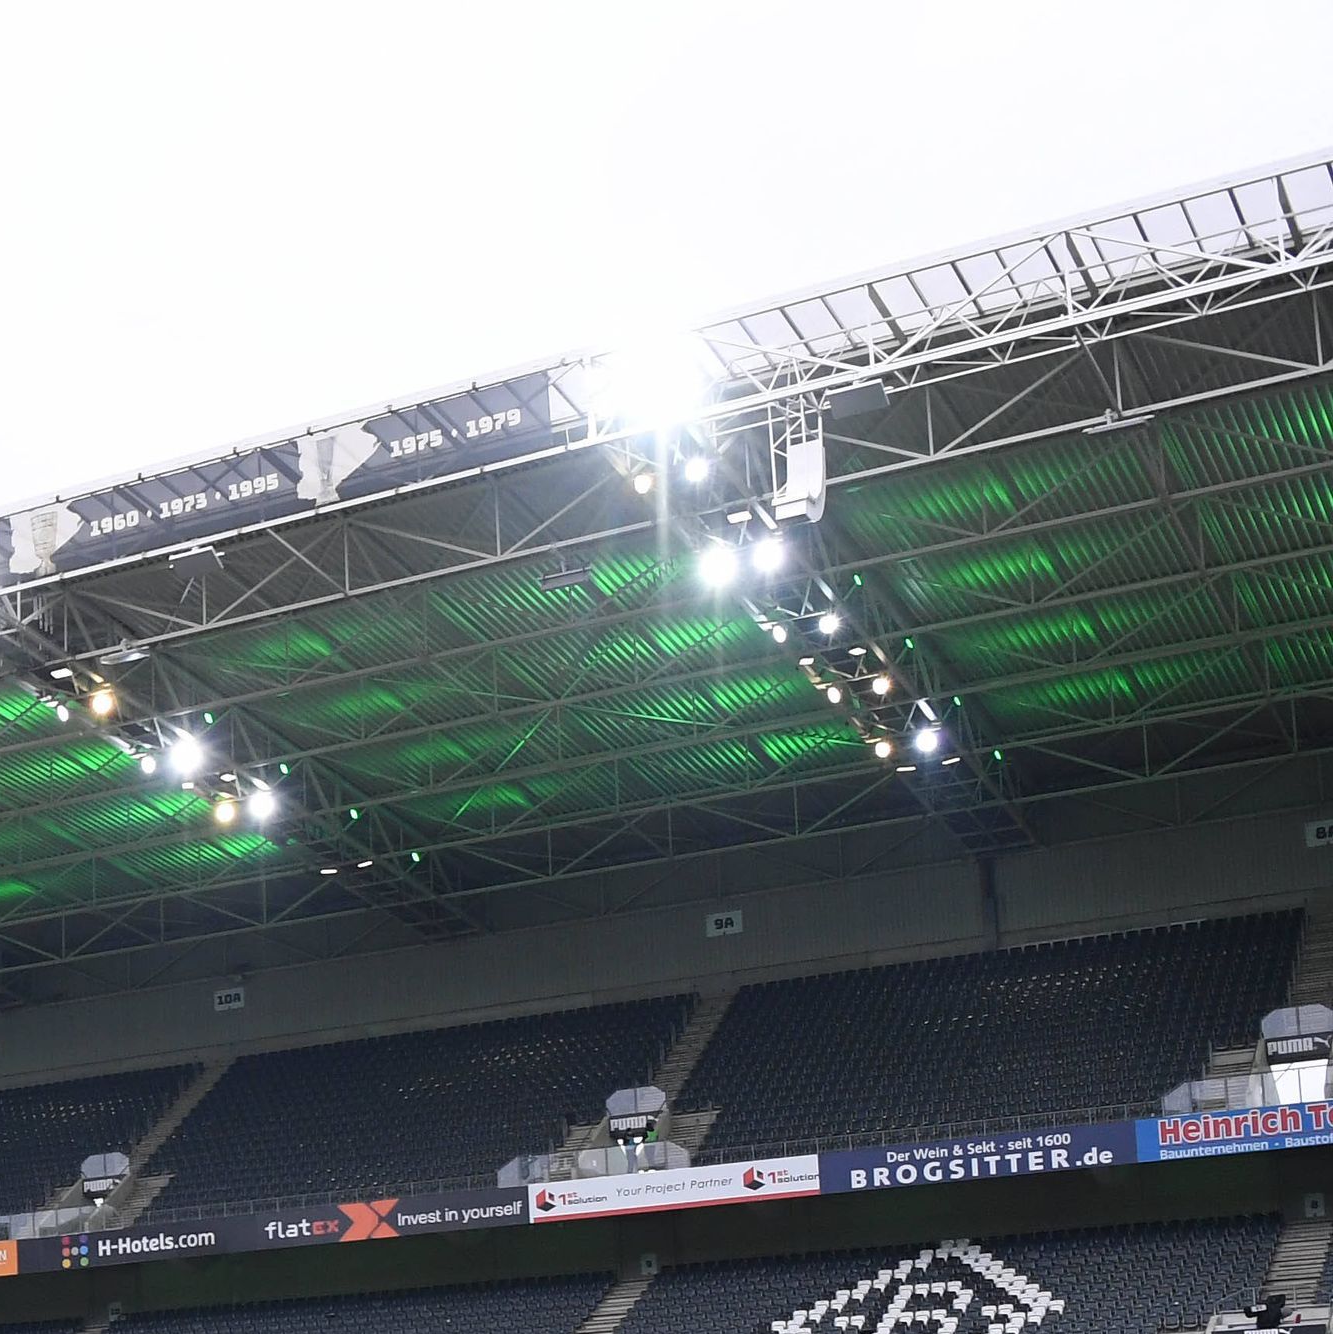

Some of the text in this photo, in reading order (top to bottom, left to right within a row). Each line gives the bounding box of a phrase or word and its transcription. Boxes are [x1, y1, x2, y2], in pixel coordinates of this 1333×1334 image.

[389, 408, 521, 459] 1975 1979
[90, 473, 279, 537] 1960 1973 1995
[714, 917, 734, 930] 9A
[217, 993, 241, 1005] 10A
[1266, 1037, 1313, 1056] PUMA
[1158, 1106, 1302, 1145] Heinrich
[886, 1149, 910, 1164] Der
[912, 1145, 949, 1161] Wein
[966, 1140, 996, 1155] Sekt
[1007, 1137, 1032, 1152] seit
[1036, 1132, 1072, 1148] 1600
[1160, 1140, 1269, 1160] Bauunternehmen
[850, 1147, 1114, 1189] BROGSITTER.de
[616, 1174, 733, 1198] Your Project Partner
[567, 1195, 608, 1205] solution
[396, 1200, 523, 1228] Invest in yourself
[97, 1230, 215, 1257] H-Hotels.com
